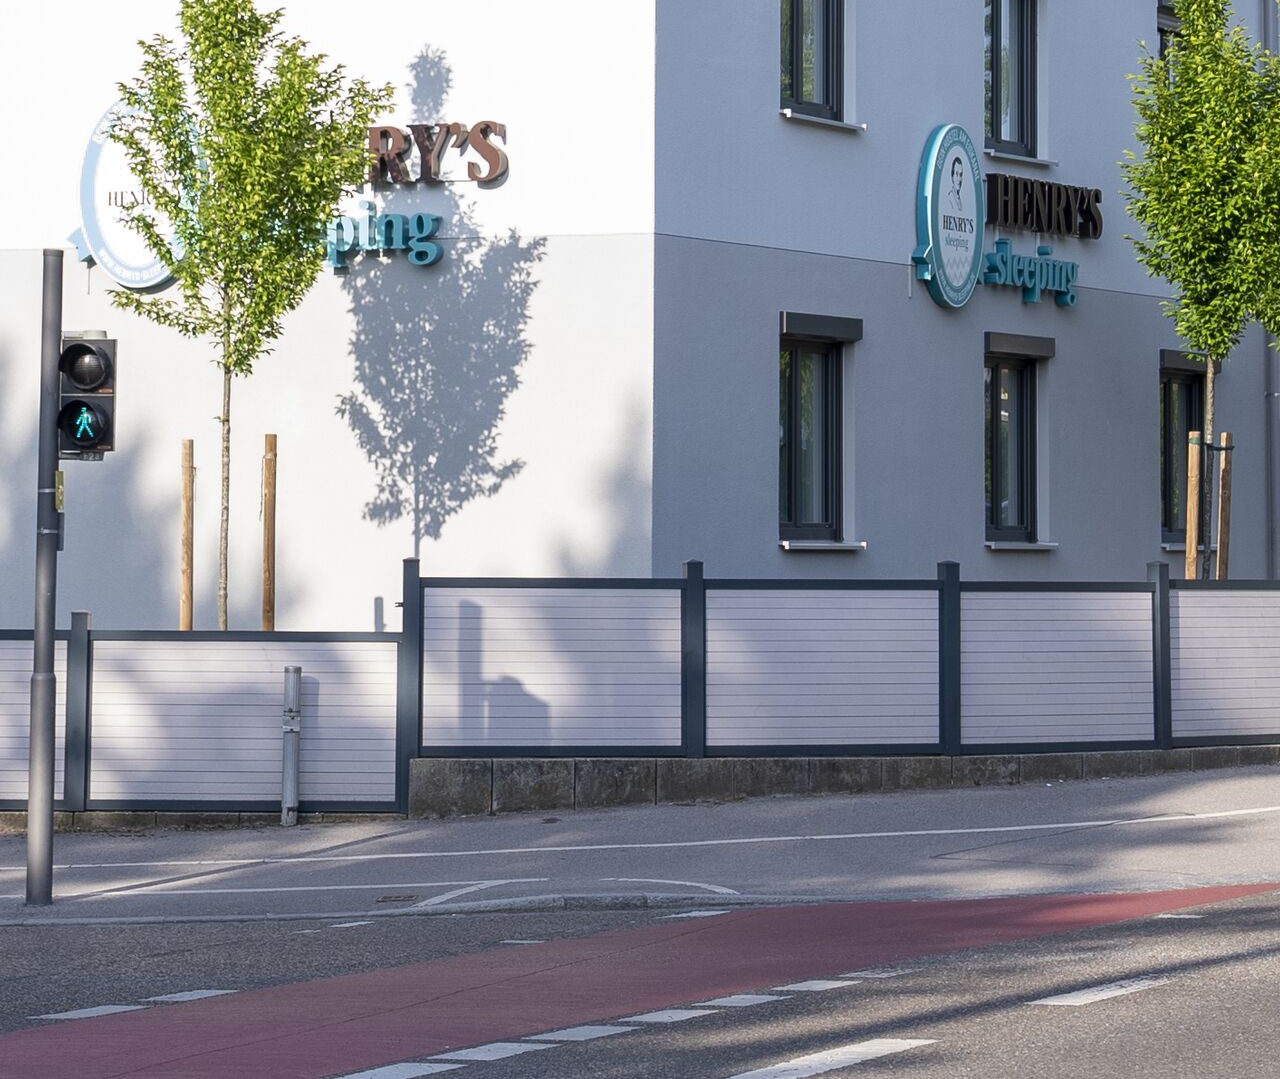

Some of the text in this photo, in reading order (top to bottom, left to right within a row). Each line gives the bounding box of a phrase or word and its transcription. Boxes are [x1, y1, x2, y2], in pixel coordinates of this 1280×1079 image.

[942, 214, 975, 234] HENRY'S
[988, 174, 1103, 240] HENRY'S
[944, 233, 969, 253] sleeping
[991, 239, 1080, 306] sleeping
